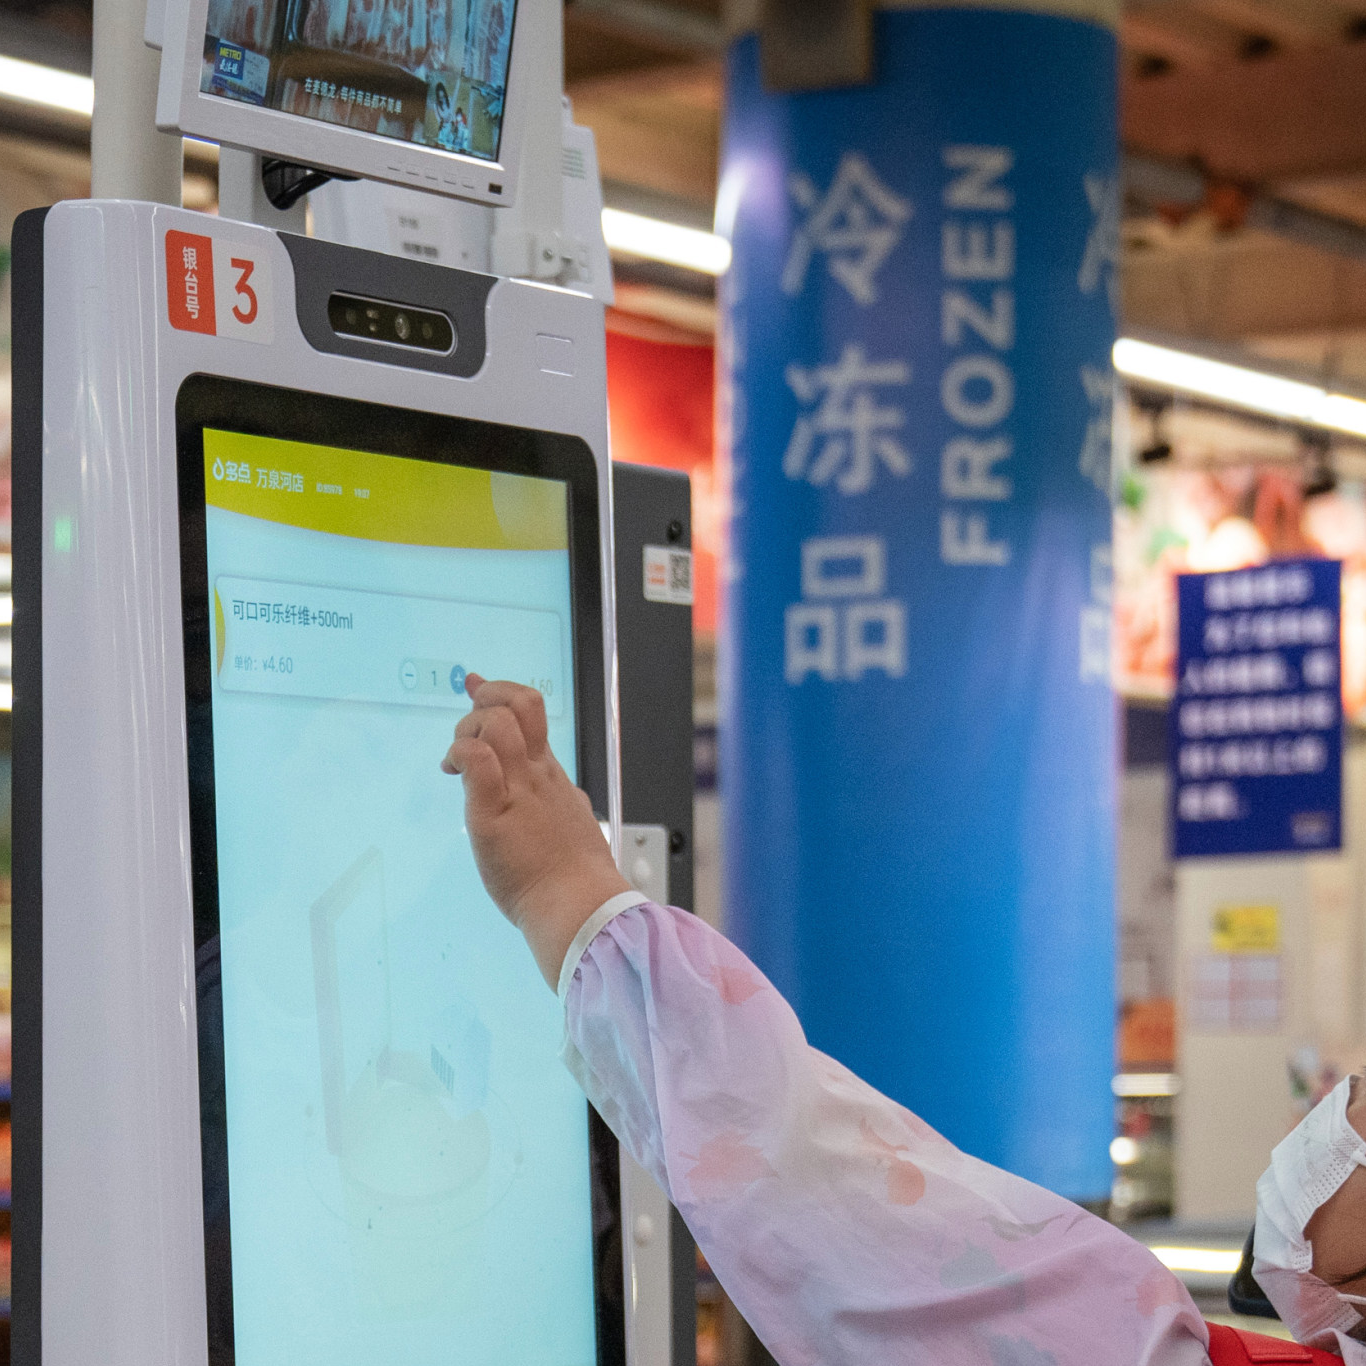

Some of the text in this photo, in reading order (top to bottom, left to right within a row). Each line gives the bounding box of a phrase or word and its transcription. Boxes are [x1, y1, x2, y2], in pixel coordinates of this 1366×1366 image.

[219, 47, 242, 61] METRO
[182, 245, 200, 320] 银台号
[230, 257, 259, 325] 3
[940, 143, 1017, 567] FROZEN
[780, 150, 915, 686] 冷冻品
[225, 461, 305, 493] 多点 万泉河店
[232, 599, 354, 630] 可口可乐纤维+500ml
[431, 669, 437, 687] 1
